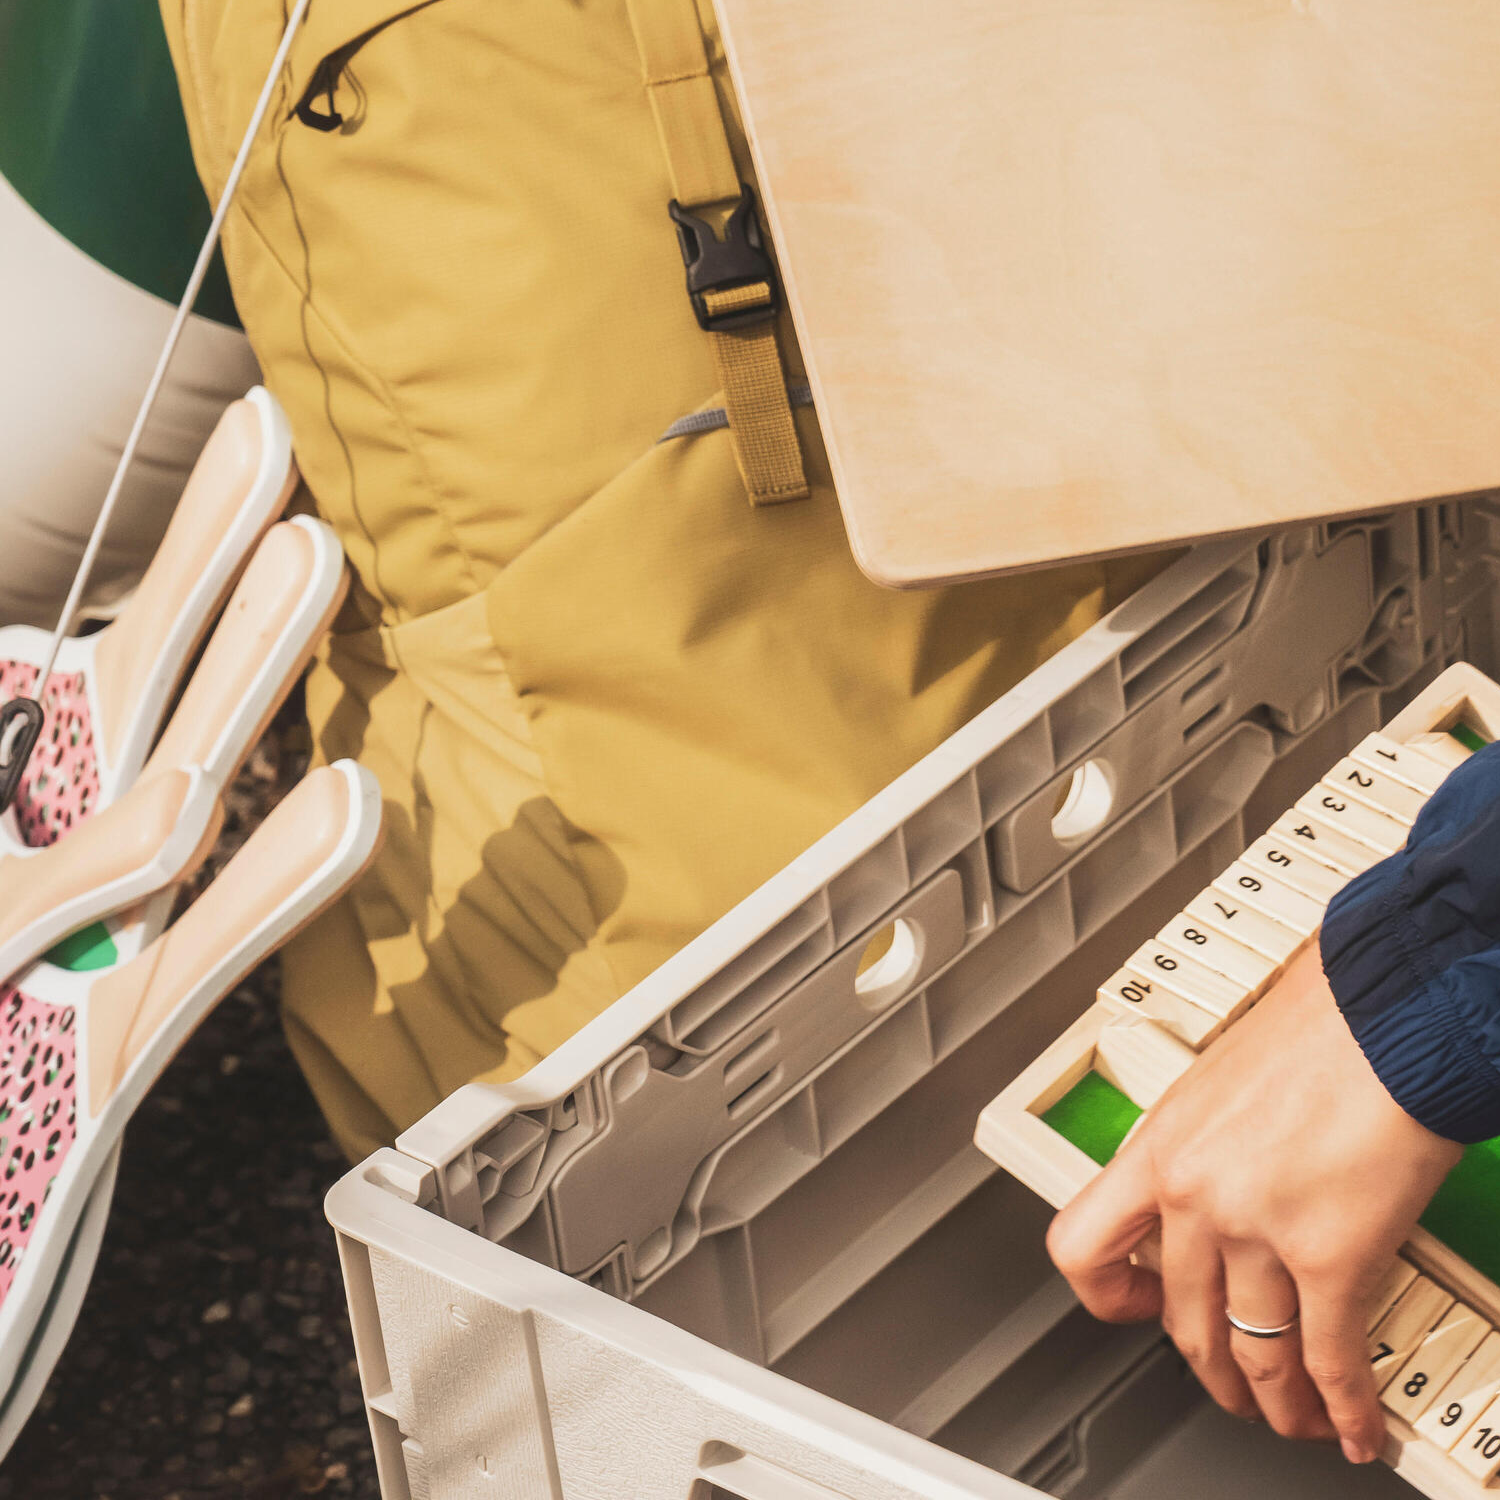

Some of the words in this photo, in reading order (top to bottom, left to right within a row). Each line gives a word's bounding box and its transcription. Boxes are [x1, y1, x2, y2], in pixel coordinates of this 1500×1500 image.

[1375, 749, 1398, 763] 1
[1347, 770, 1373, 788] 2
[1321, 796, 1346, 813] 3
[1293, 824, 1317, 842] 4
[1266, 850, 1291, 868] 5
[1238, 875, 1262, 893] 6
[1214, 902, 1238, 920] 7
[1183, 928, 1207, 945] 8
[1154, 954, 1178, 972] 9
[1120, 979, 1152, 1003] 10
[1370, 1342, 1394, 1365] 7
[1403, 1371, 1429, 1398] 8
[1440, 1402, 1463, 1428] 9
